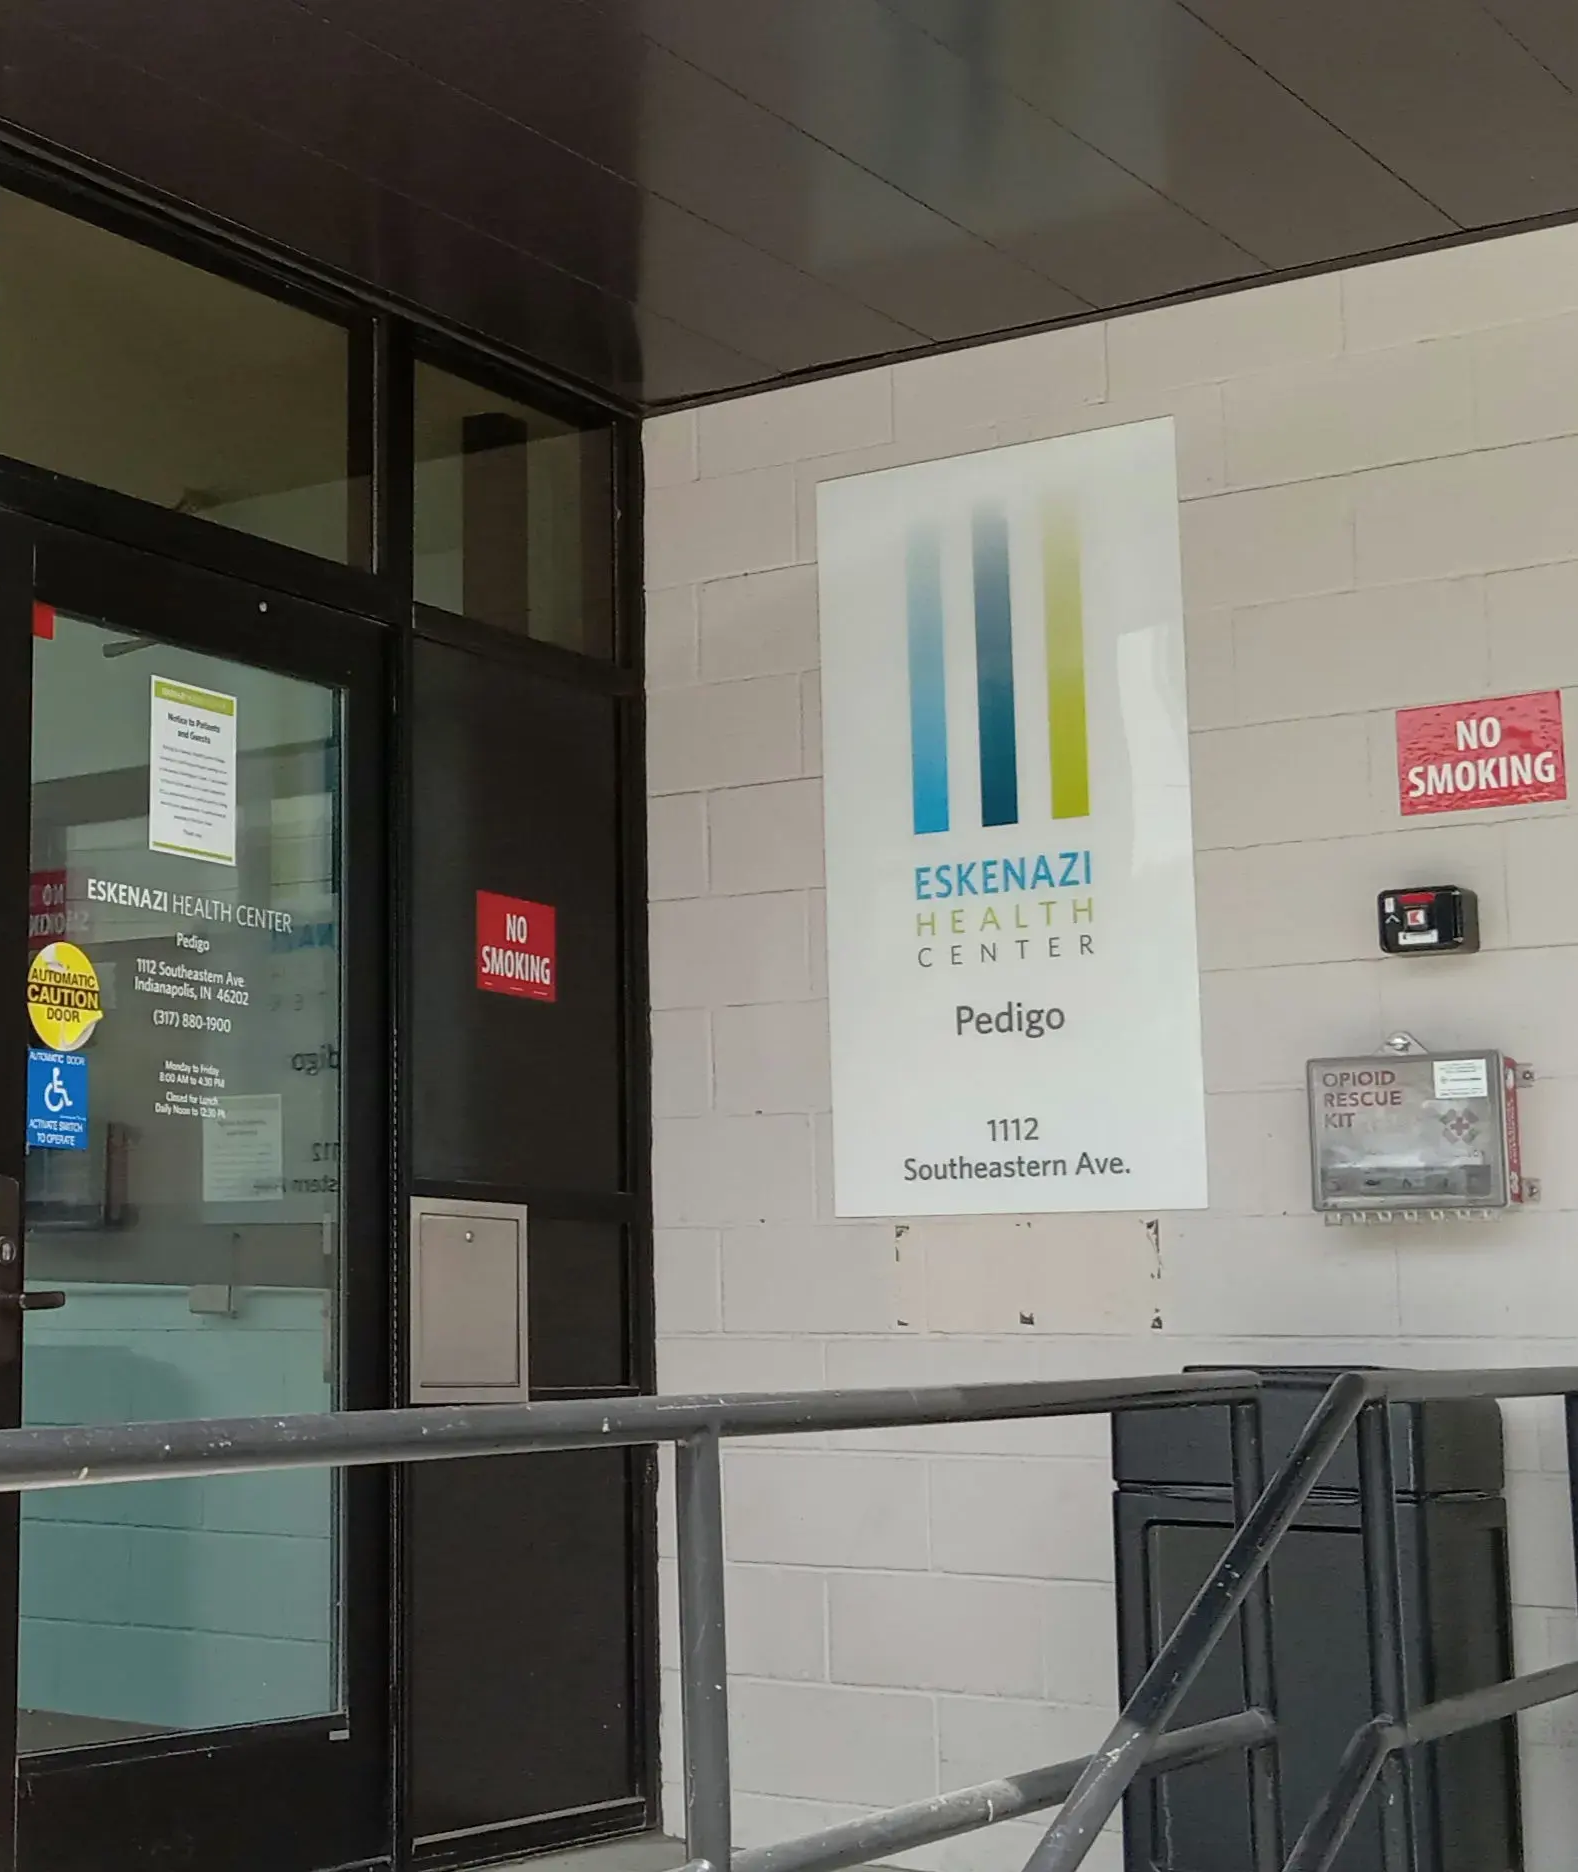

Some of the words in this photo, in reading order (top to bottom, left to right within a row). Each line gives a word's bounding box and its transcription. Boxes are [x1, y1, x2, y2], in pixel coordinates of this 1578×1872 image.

[1455, 716, 1502, 751] NO
[1407, 750, 1556, 799] SMOKING
[914, 850, 1093, 901] ESKENAZI
[87, 878, 168, 912] ESKENAZI
[172, 894, 232, 923] HEALTH
[236, 905, 293, 934] CENTER
[916, 896, 1095, 937] HEALTH
[175, 932, 210, 953] Pedigo
[506, 913, 528, 944] NO
[481, 945, 551, 985] SMOKING
[917, 934, 1095, 968] CENTER
[31, 967, 96, 989] AUTOMATIC
[136, 958, 156, 975] 1112
[159, 961, 223, 983] Southeastern
[226, 972, 245, 988] Ave
[27, 984, 99, 1010] CAUTION
[134, 976, 198, 1001] Indianapolis,
[200, 985, 212, 1000] IN
[216, 989, 250, 1006] 46202
[46, 1007, 81, 1023] DOOR
[153, 1009, 179, 1027] (317)
[182, 1012, 232, 1033] 880-1900
[955, 1001, 1066, 1039] Pedigo
[29, 1051, 64, 1063] AUTOMATIC
[66, 1055, 86, 1066] DOOR
[165, 1060, 191, 1074] Monday
[1322, 1070, 1396, 1088] OPIOID
[1323, 1090, 1403, 1108] RESCUE
[987, 1117, 1040, 1142] 1112
[1324, 1112, 1356, 1129] KIT
[903, 1155, 1068, 1182] Southeastern
[1075, 1152, 1131, 1176] Ave.
